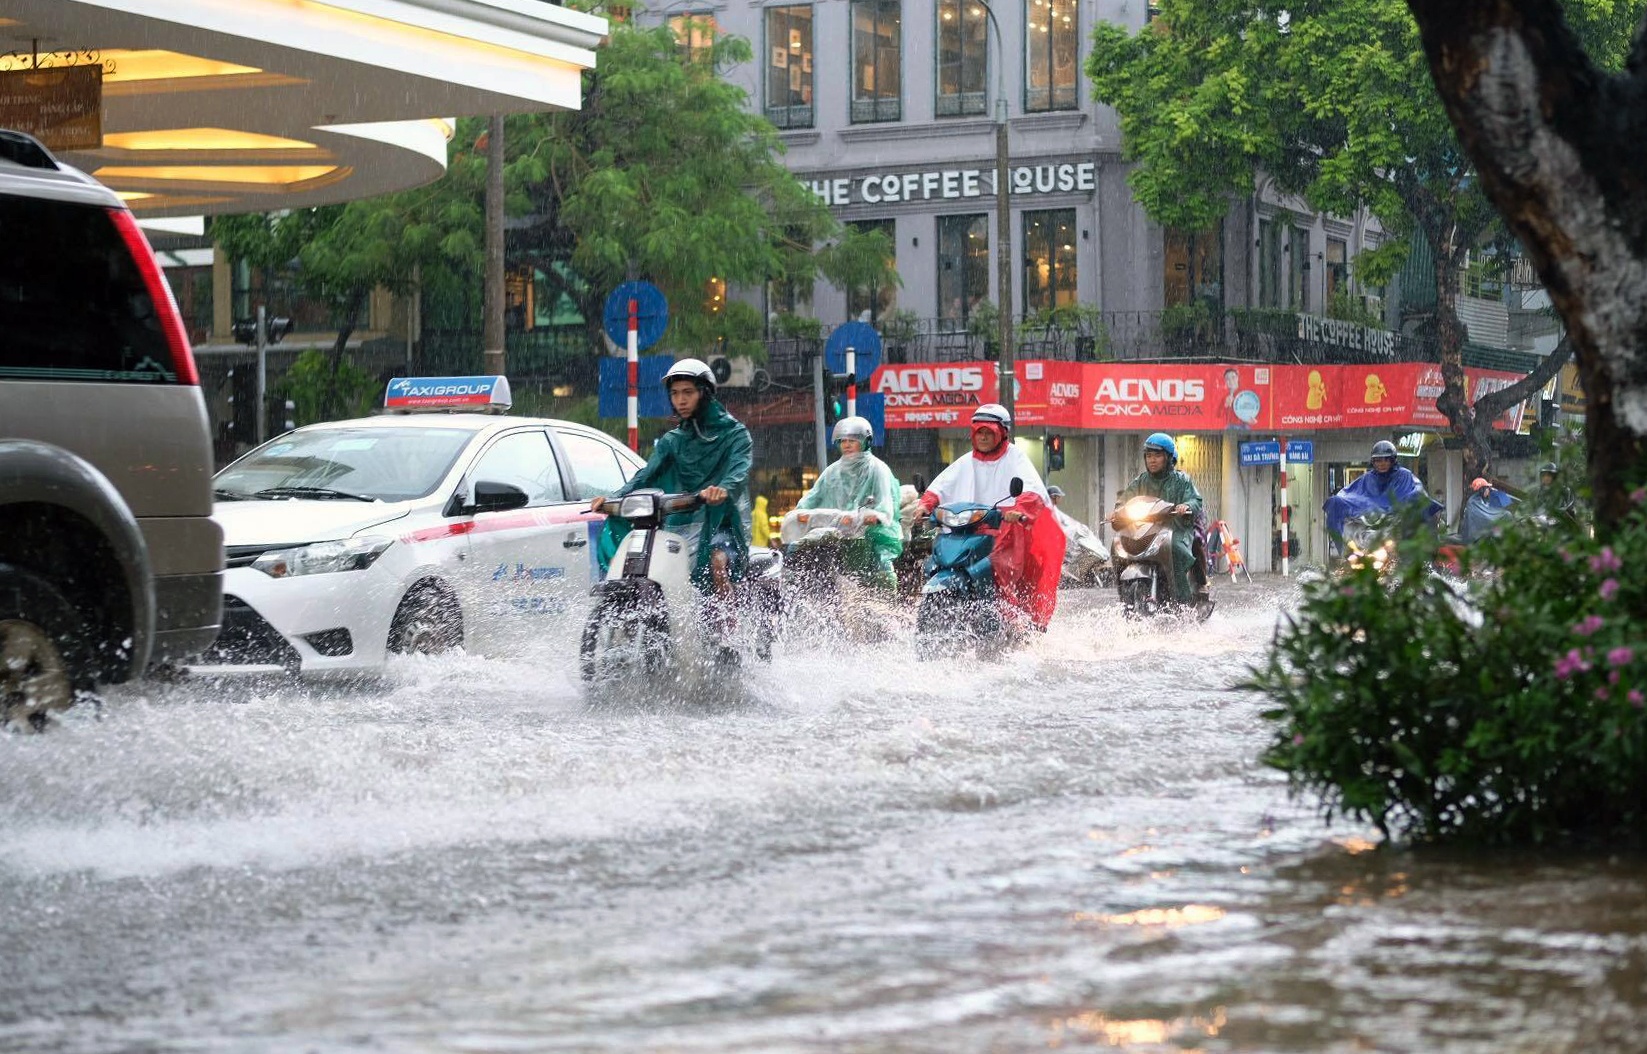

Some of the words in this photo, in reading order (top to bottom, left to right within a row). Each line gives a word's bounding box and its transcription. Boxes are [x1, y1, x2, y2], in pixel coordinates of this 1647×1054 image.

[797, 178, 850, 205] HE
[861, 169, 980, 203] COFFEE
[1297, 313, 1319, 341] THE
[1320, 319, 1361, 349] COFFEE
[1364, 327, 1394, 356] HOUSE
[401, 384, 491, 397] TAXIGROUP
[876, 367, 983, 393] ACNOS
[1049, 382, 1079, 398] ACNOS
[1094, 378, 1205, 402] ACNOS
